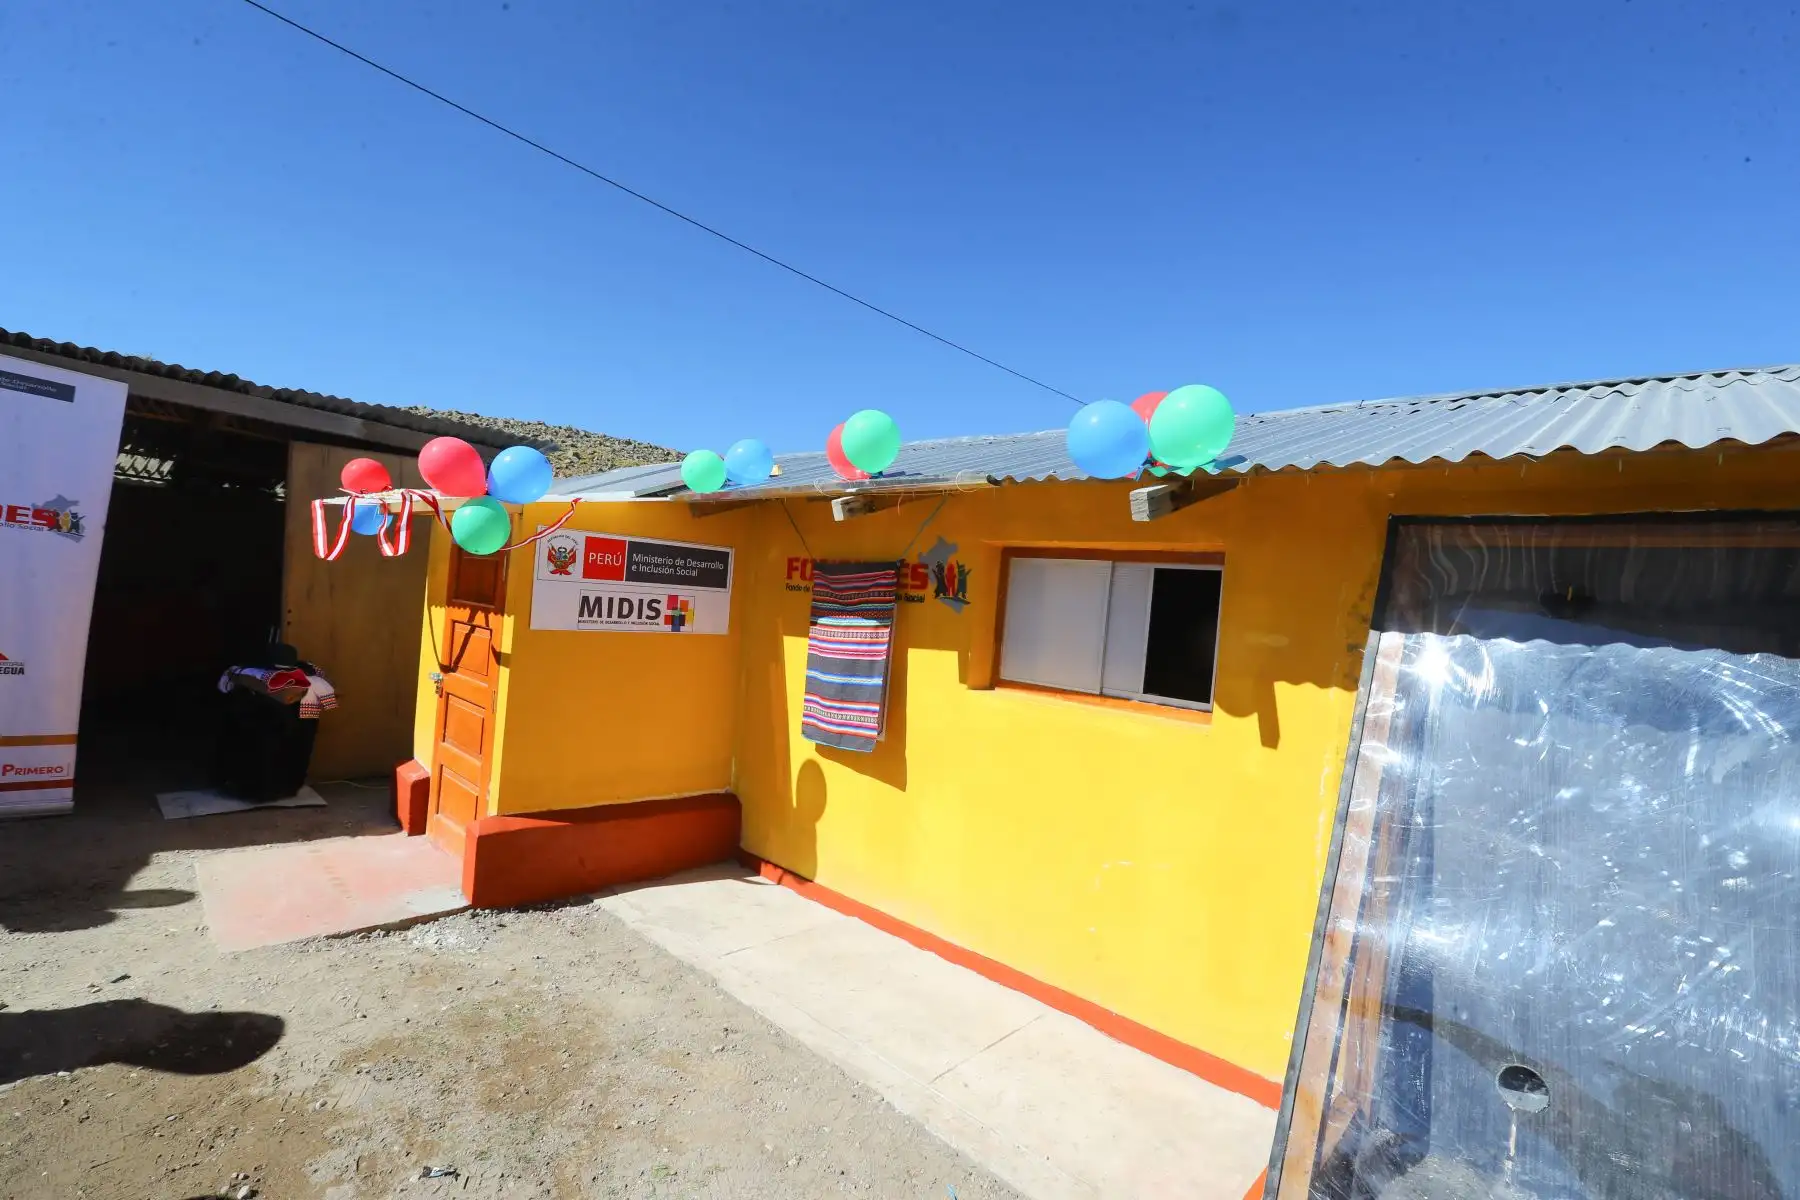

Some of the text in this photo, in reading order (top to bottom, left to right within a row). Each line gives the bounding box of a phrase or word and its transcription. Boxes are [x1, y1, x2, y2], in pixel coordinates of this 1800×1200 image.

[588, 551, 622, 566] PERÚ
[632, 553, 724, 570] Ministerio de Desarrollo
[639, 563, 675, 575] Inclusión
[676, 566, 698, 577] Social
[578, 595, 662, 621] MIDIS
